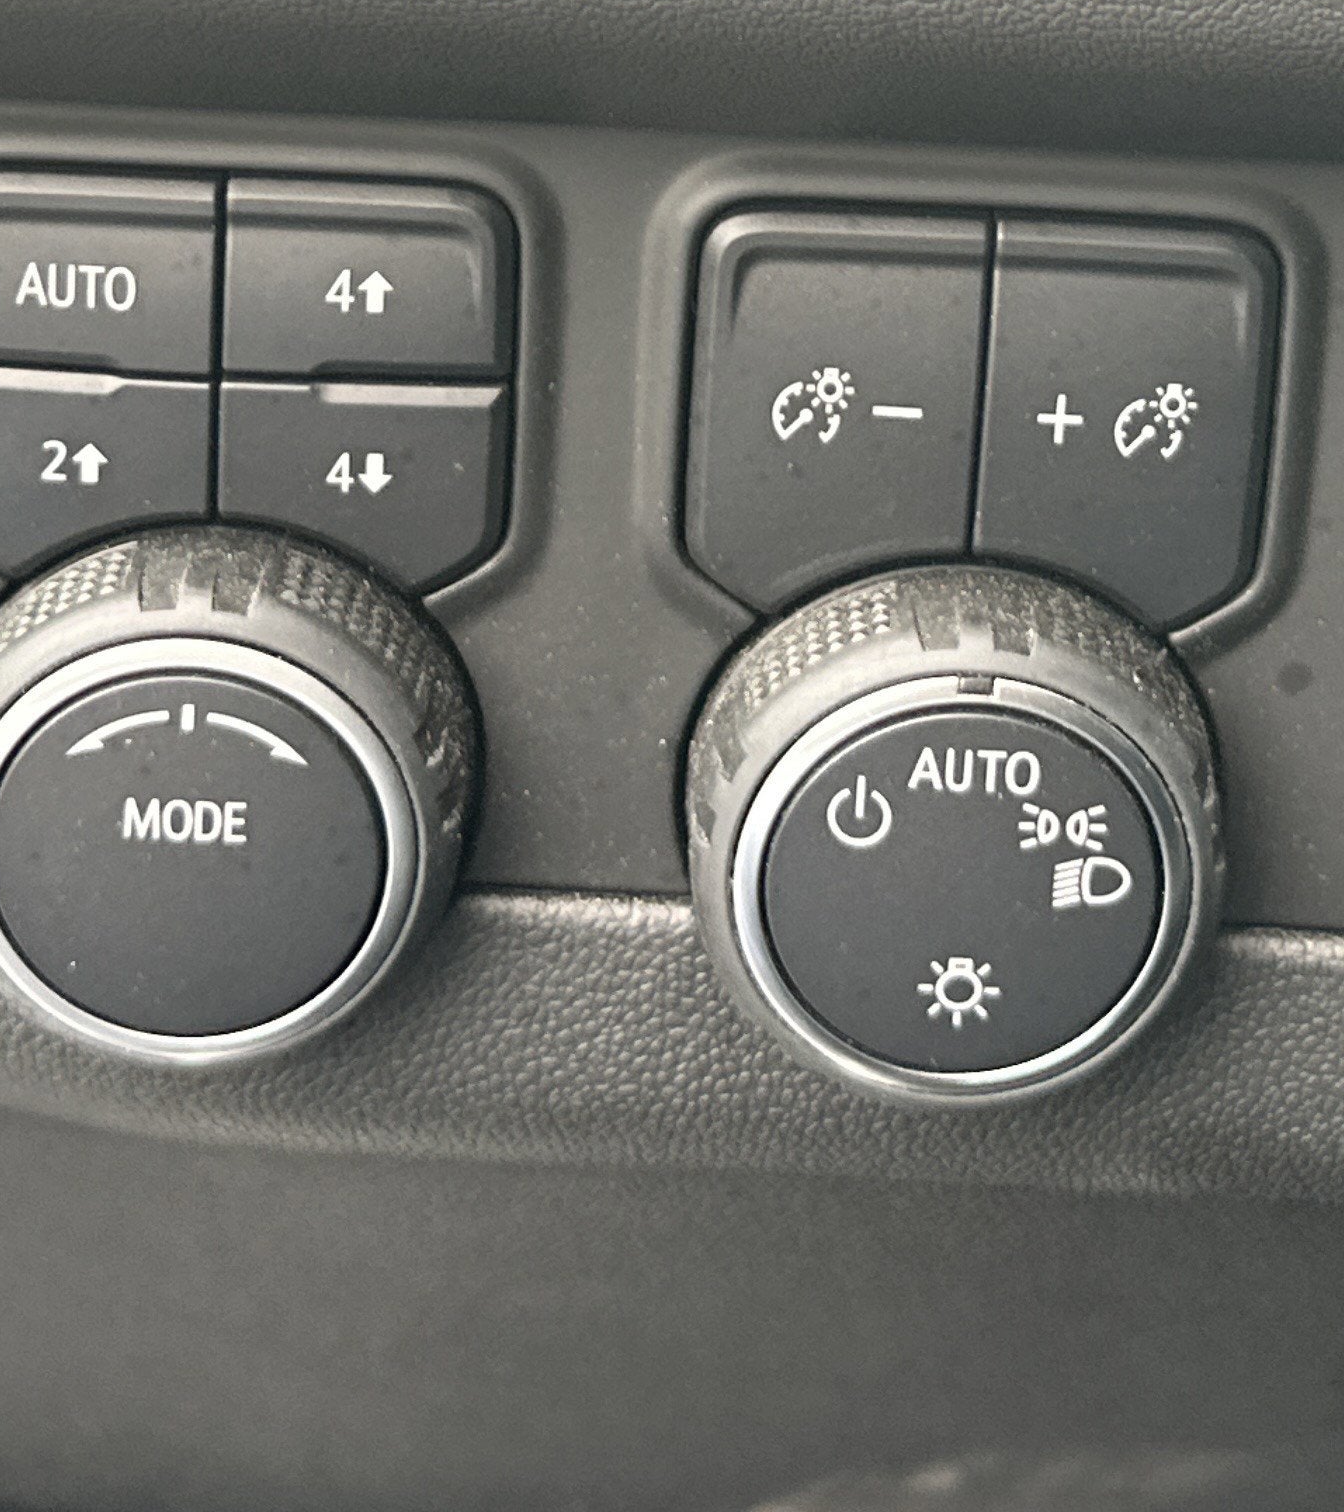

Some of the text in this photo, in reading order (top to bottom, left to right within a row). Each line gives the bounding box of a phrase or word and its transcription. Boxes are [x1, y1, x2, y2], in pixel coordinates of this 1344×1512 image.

[14, 261, 137, 312] AUTO
[324, 268, 355, 313] 4
[40, 439, 68, 483] 2
[324, 452, 355, 493] 4
[906, 746, 1042, 795] AUTO
[121, 796, 248, 845] MODE
